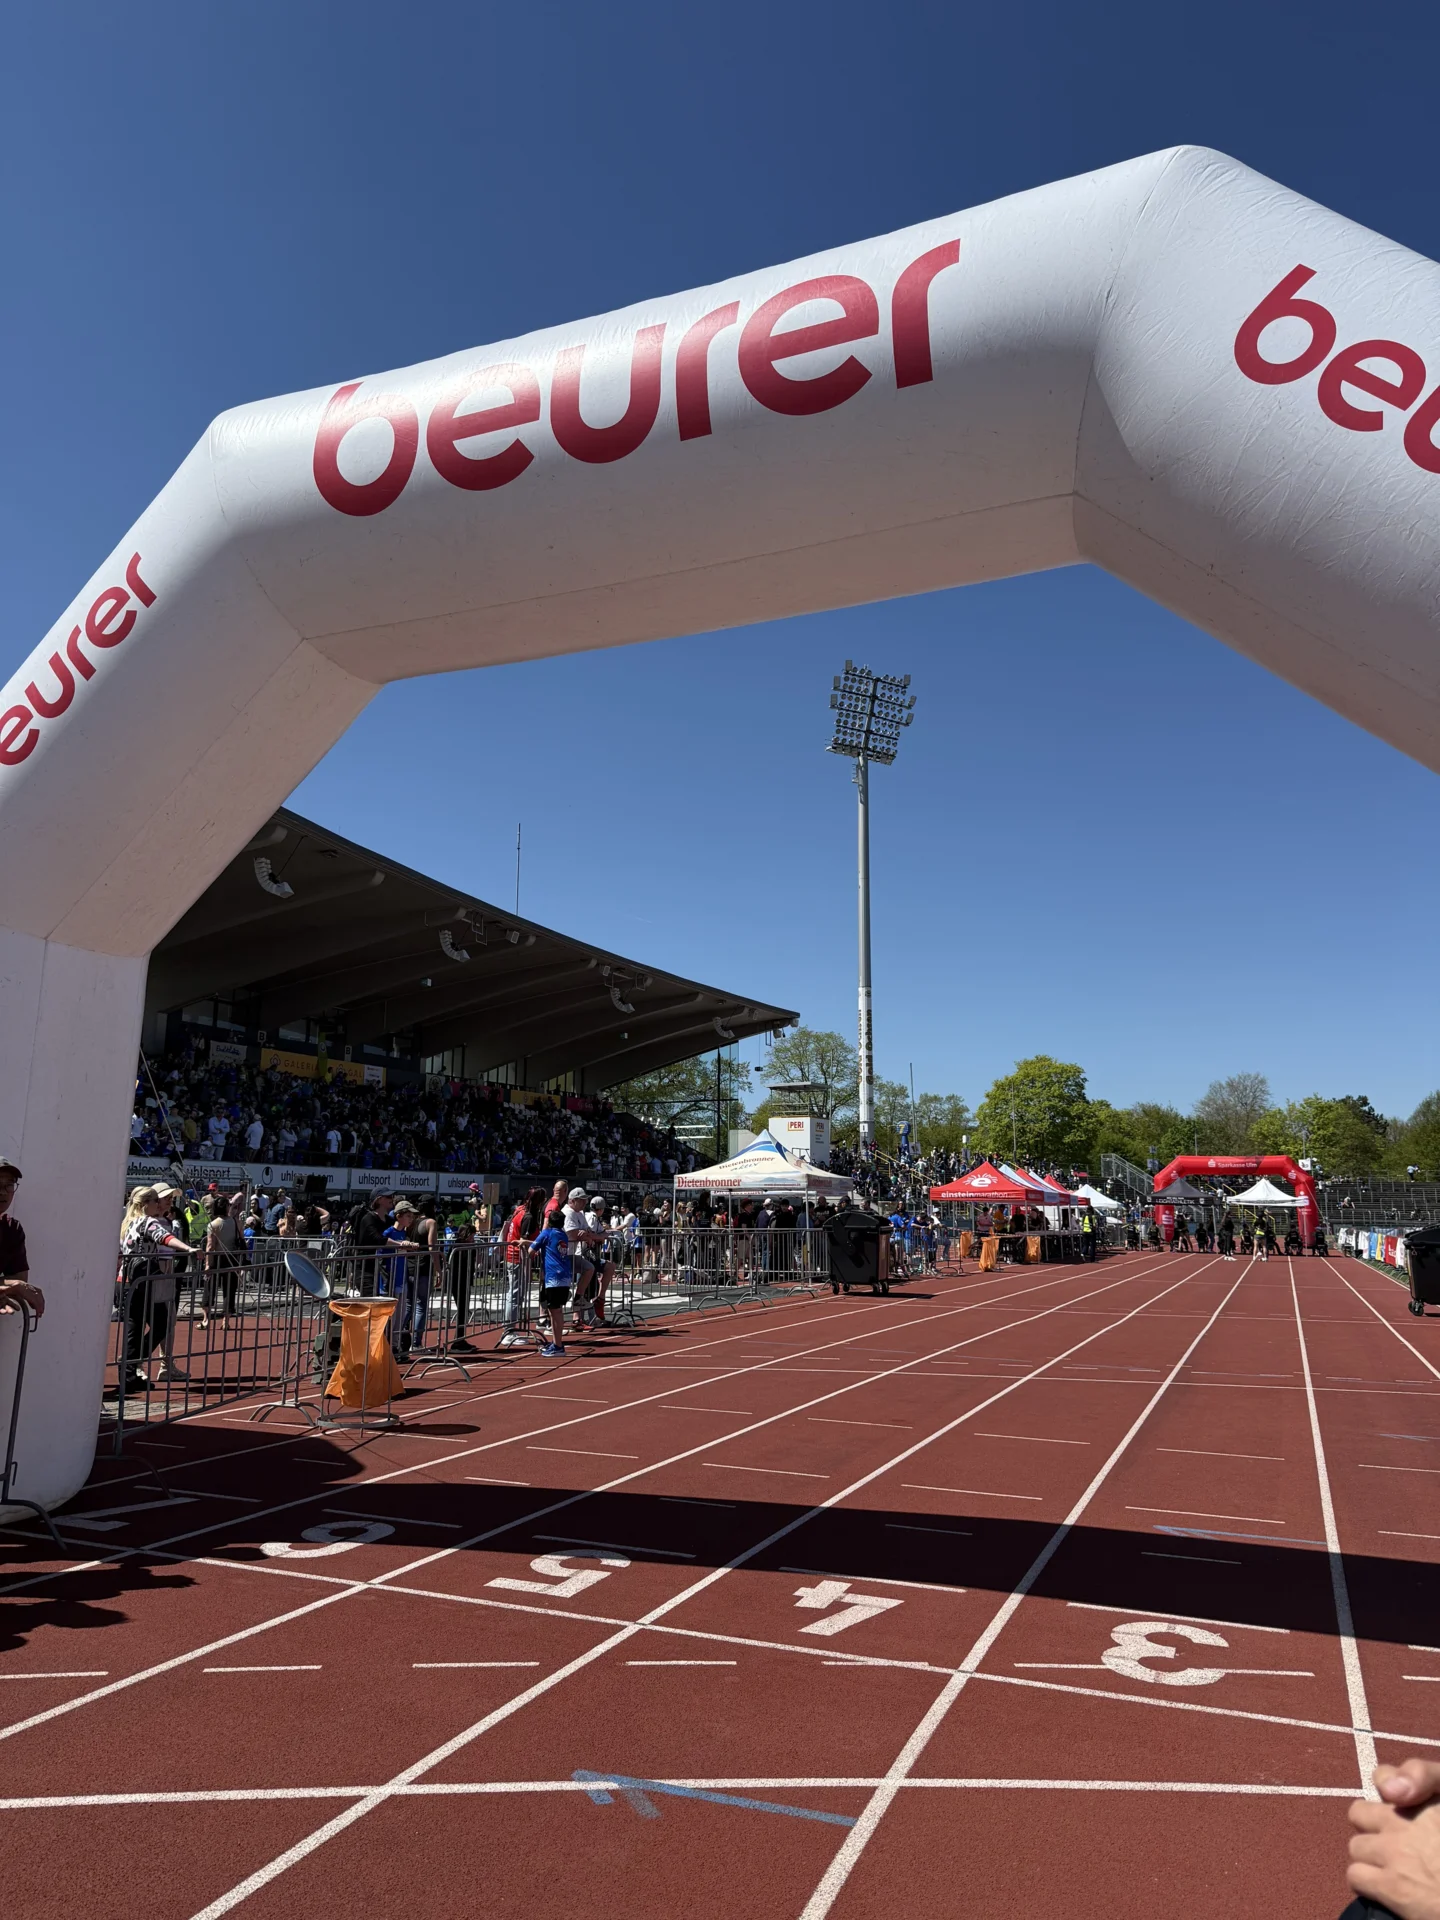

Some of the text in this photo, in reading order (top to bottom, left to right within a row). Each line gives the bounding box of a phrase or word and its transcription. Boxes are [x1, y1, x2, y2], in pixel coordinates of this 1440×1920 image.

[313, 238, 961, 517] beurer
[0, 551, 157, 766] eurer
[789, 1121, 804, 1129] PERI
[358, 1173, 391, 1187] uhlsport
[399, 1174, 430, 1188] uhlsport
[677, 1176, 742, 1188] Dietenbronner
[484, 1548, 632, 1600] 5
[792, 1579, 906, 1637] 4
[1101, 1621, 1229, 1687] 3
